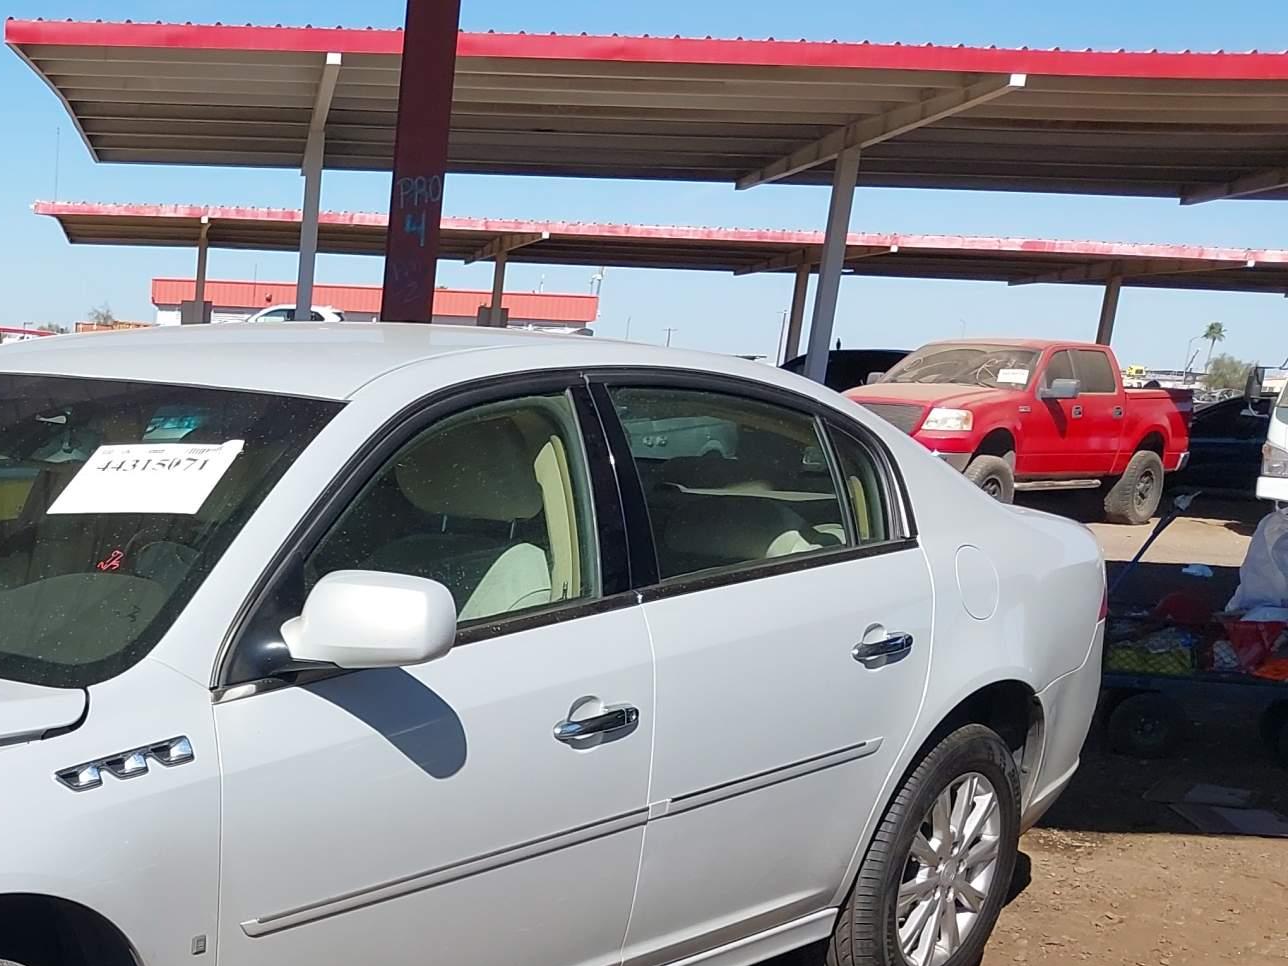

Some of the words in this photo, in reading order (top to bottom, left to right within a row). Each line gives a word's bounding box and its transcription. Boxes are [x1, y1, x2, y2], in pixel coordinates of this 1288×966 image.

[397, 175, 442, 209] PRO
[404, 208, 427, 247] 4
[95, 457, 211, 473] 44315071
